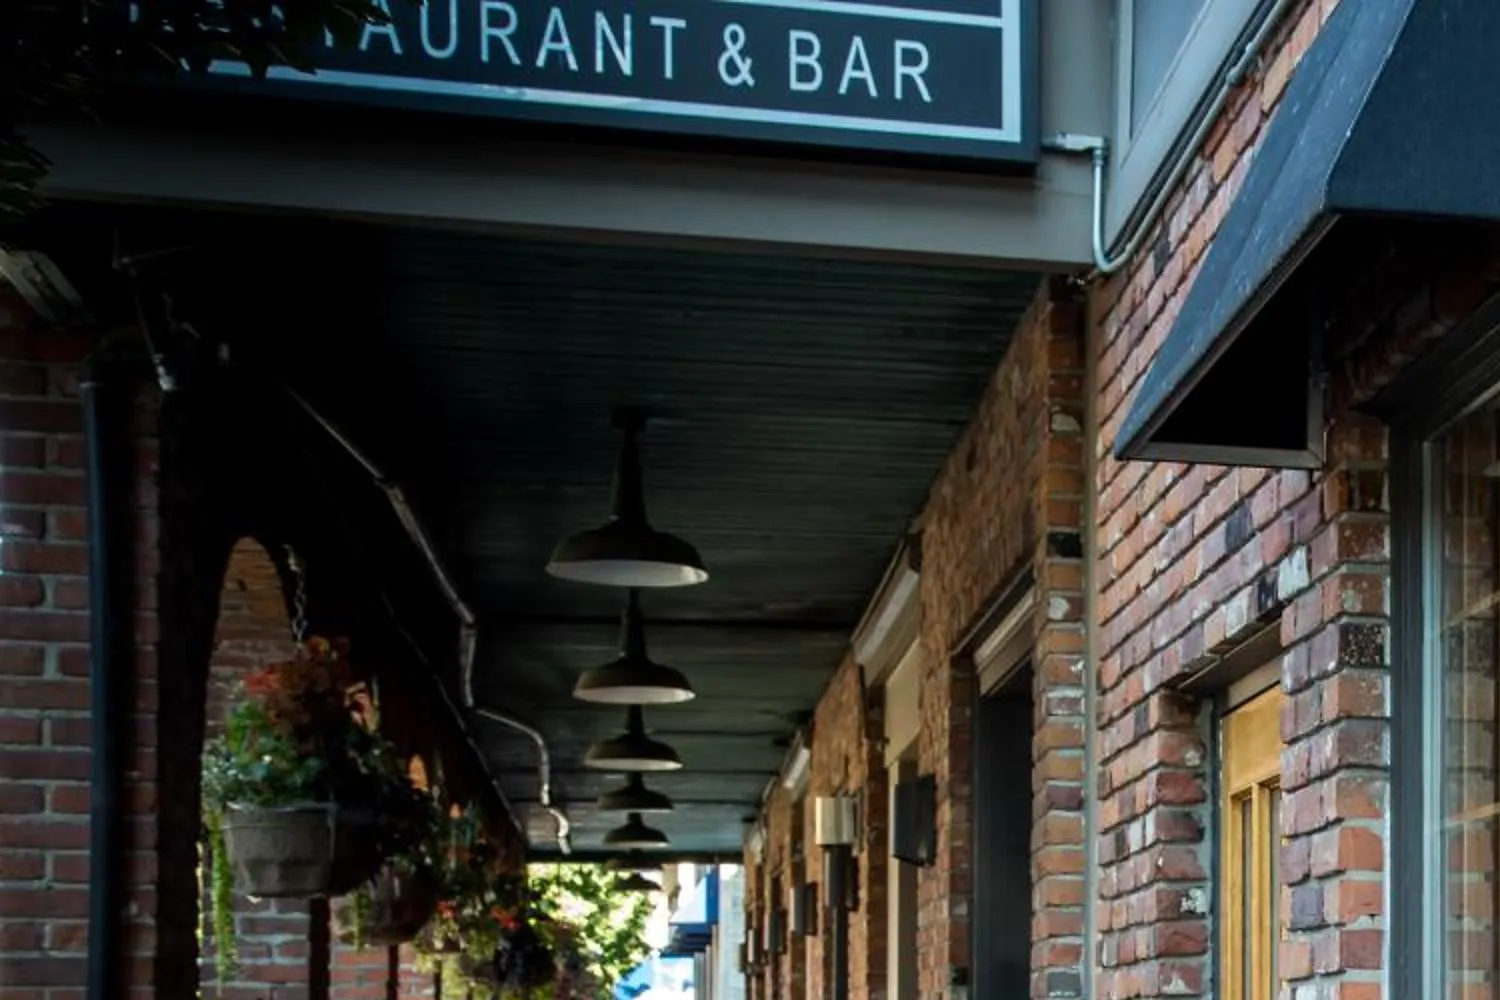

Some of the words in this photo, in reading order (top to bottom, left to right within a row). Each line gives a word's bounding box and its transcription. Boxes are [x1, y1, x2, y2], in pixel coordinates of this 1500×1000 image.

[131, 0, 687, 79] AURANT
[717, 23, 755, 87] &
[788, 29, 932, 103] BAR
